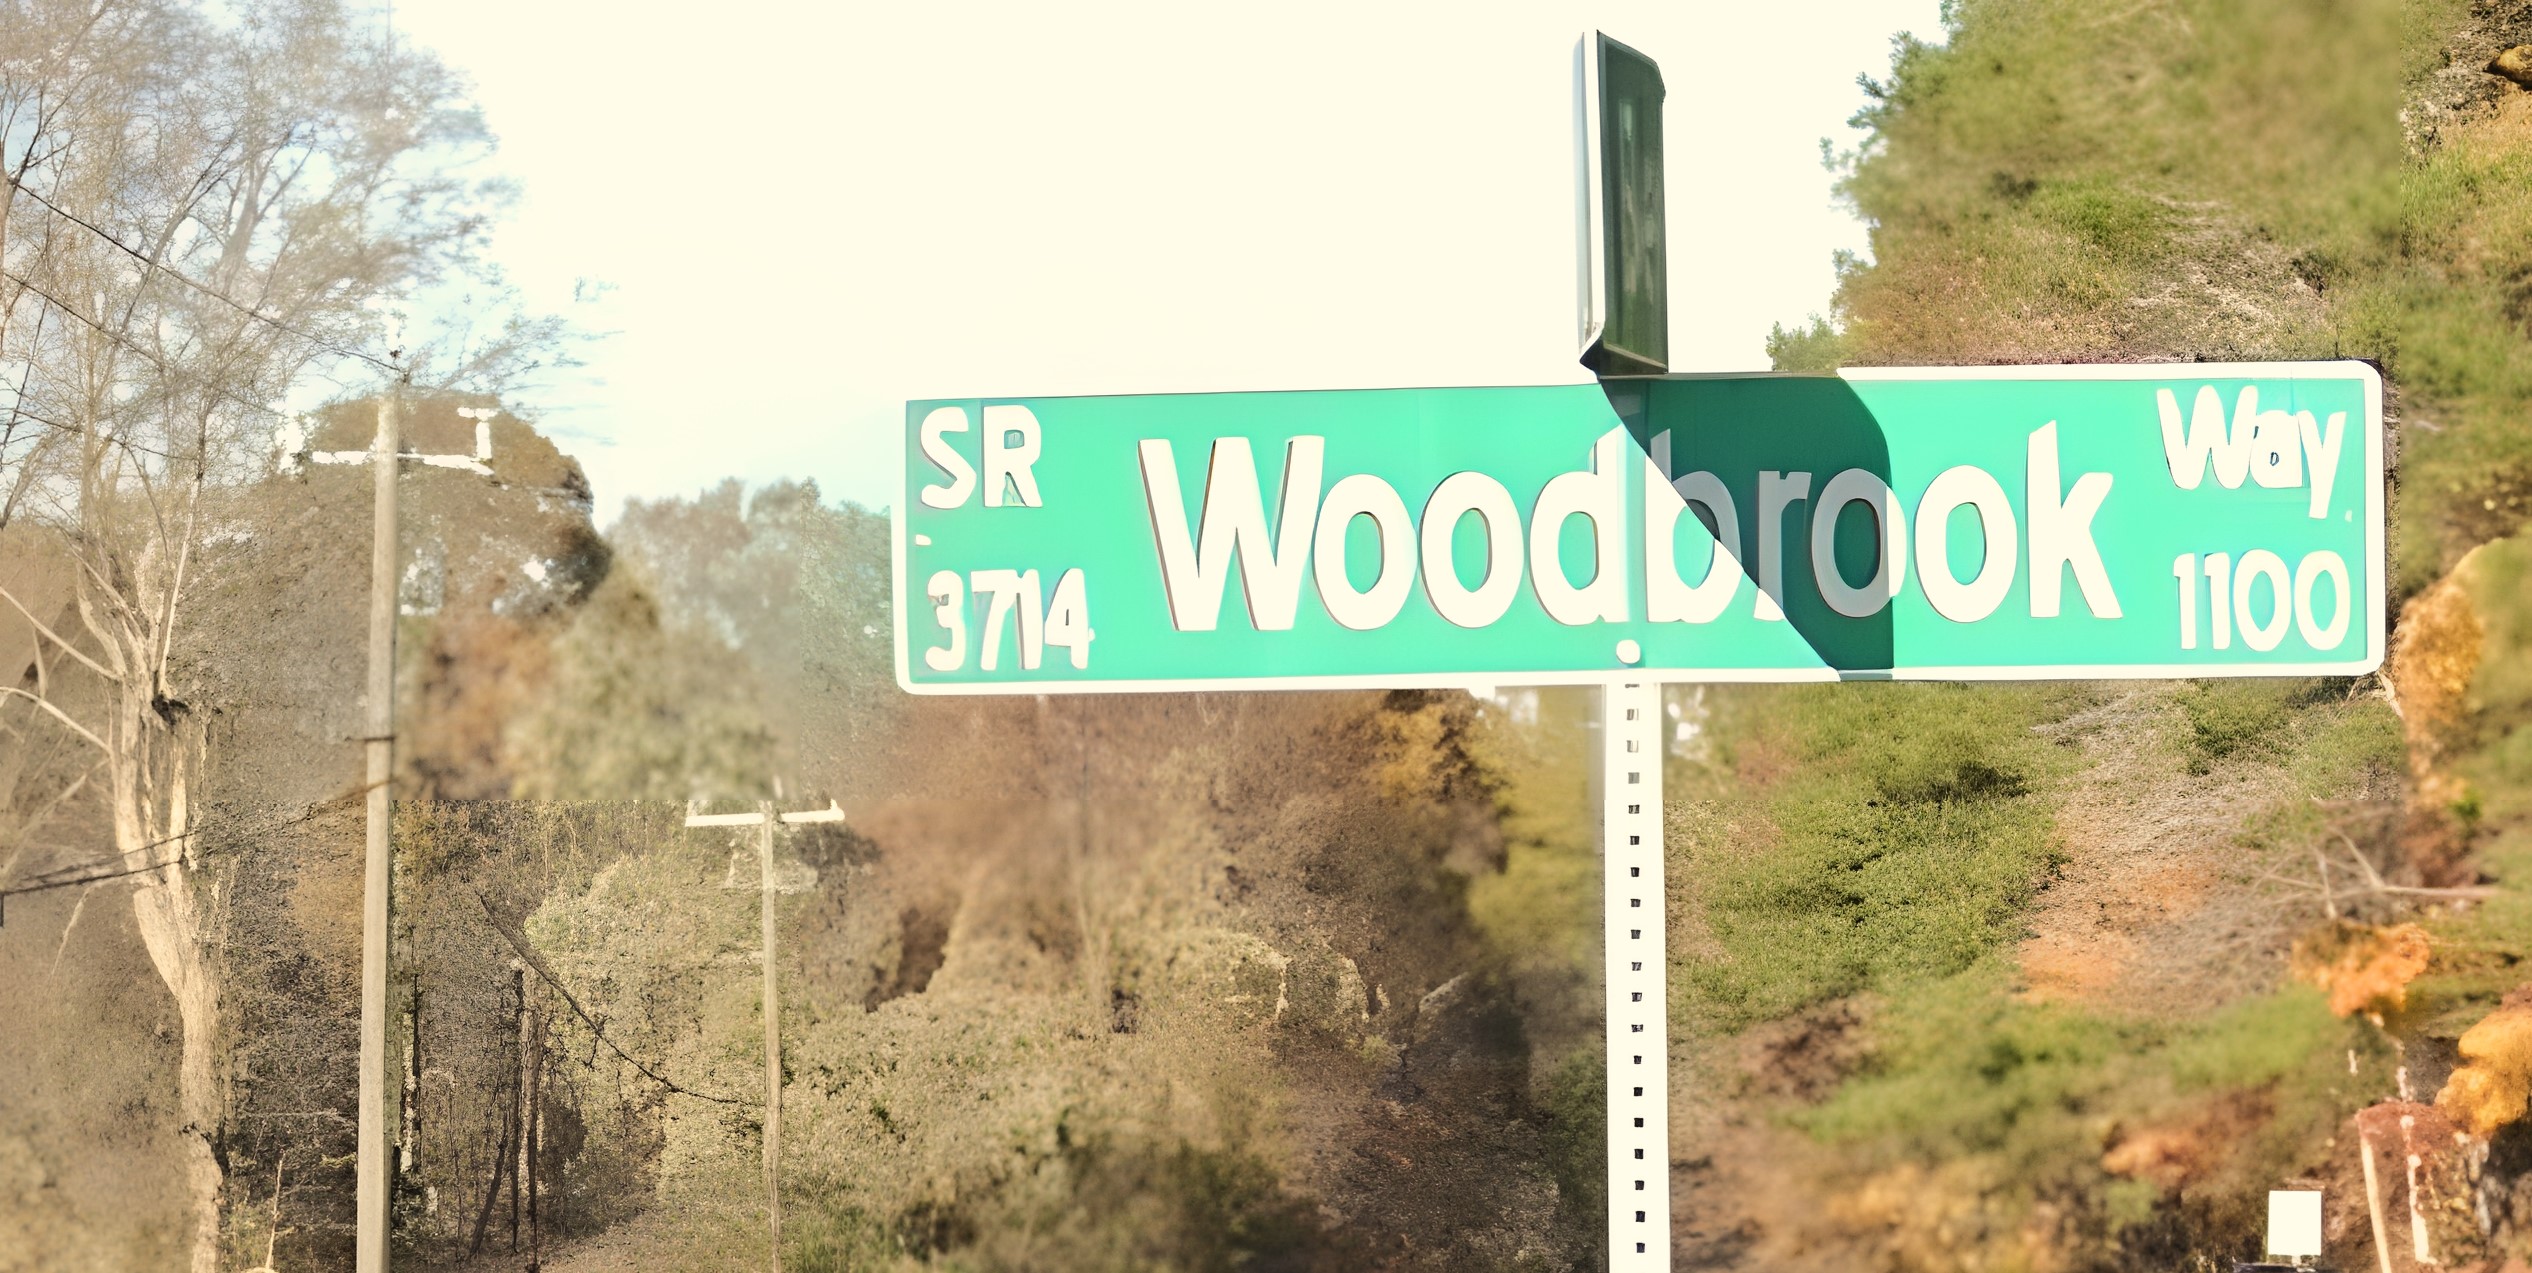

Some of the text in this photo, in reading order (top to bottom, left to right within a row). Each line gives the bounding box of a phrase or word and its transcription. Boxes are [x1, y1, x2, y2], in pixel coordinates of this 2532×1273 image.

[921, 405, 1043, 510] SR
[2156, 384, 2347, 519] Way
[1137, 420, 2123, 632] Woodbrook
[925, 567, 1090, 672] 3714
[2173, 548, 2351, 652] 1100
